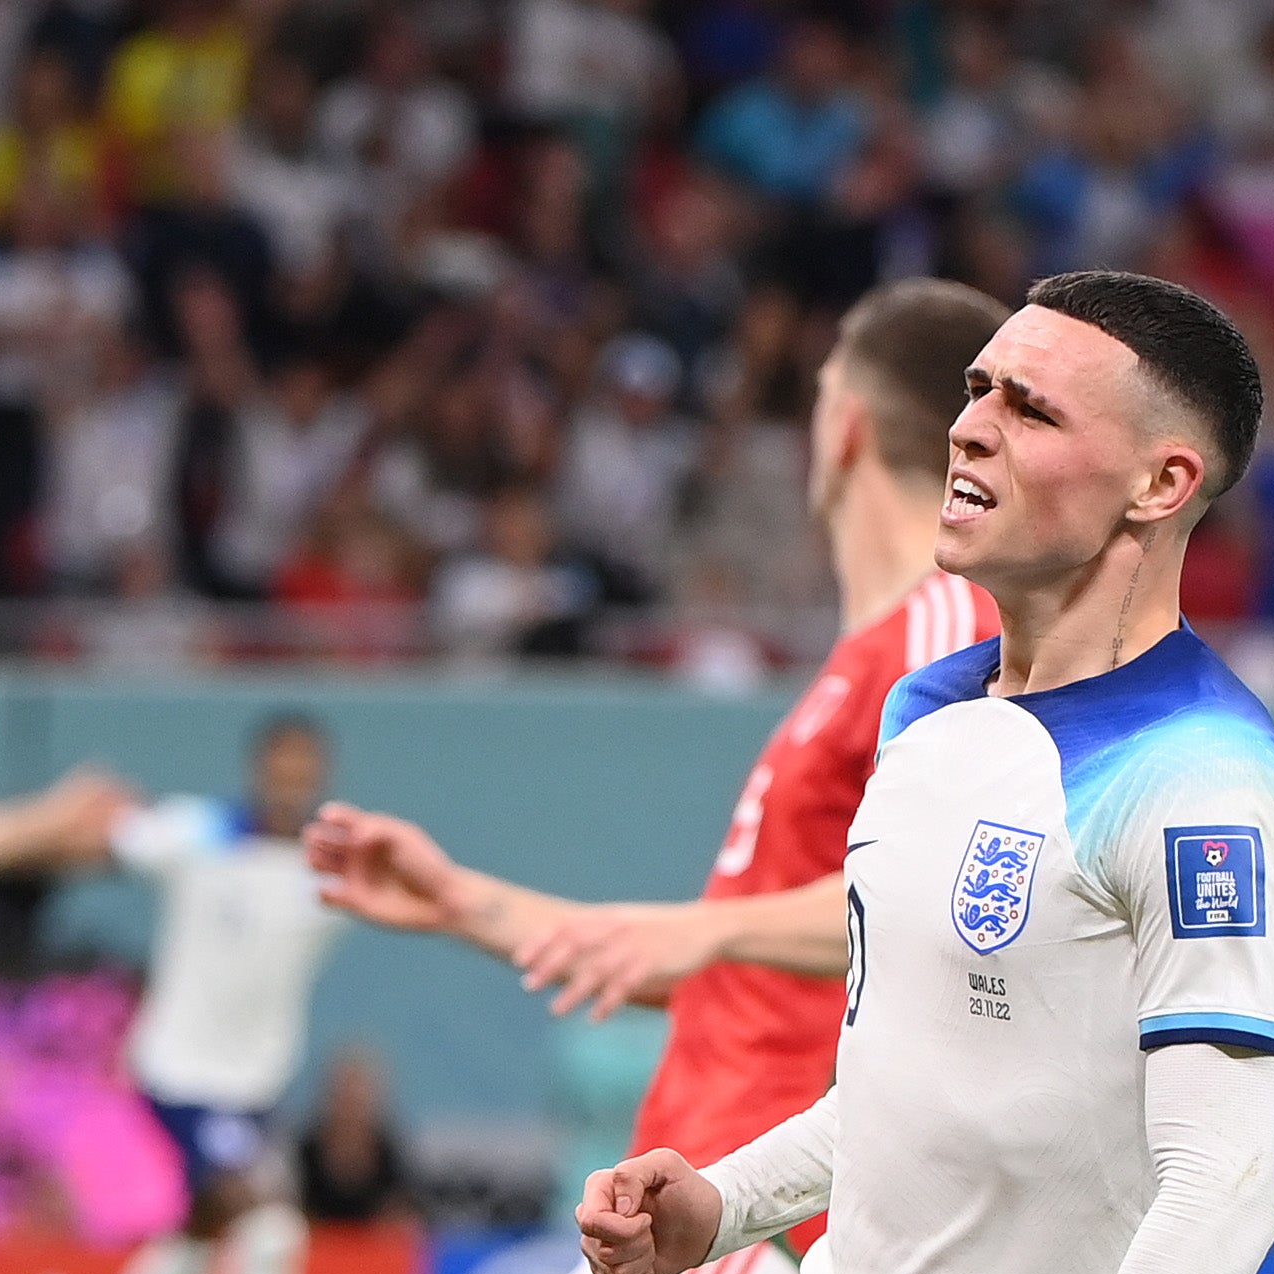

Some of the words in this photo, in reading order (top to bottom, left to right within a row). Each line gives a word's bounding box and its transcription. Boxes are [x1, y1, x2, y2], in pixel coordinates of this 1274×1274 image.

[1196, 871, 1236, 883] FOOTBALL
[1196, 882, 1237, 897] UNITES
[968, 972, 1007, 996] WALES
[969, 997, 1011, 1021] 29.11.22
